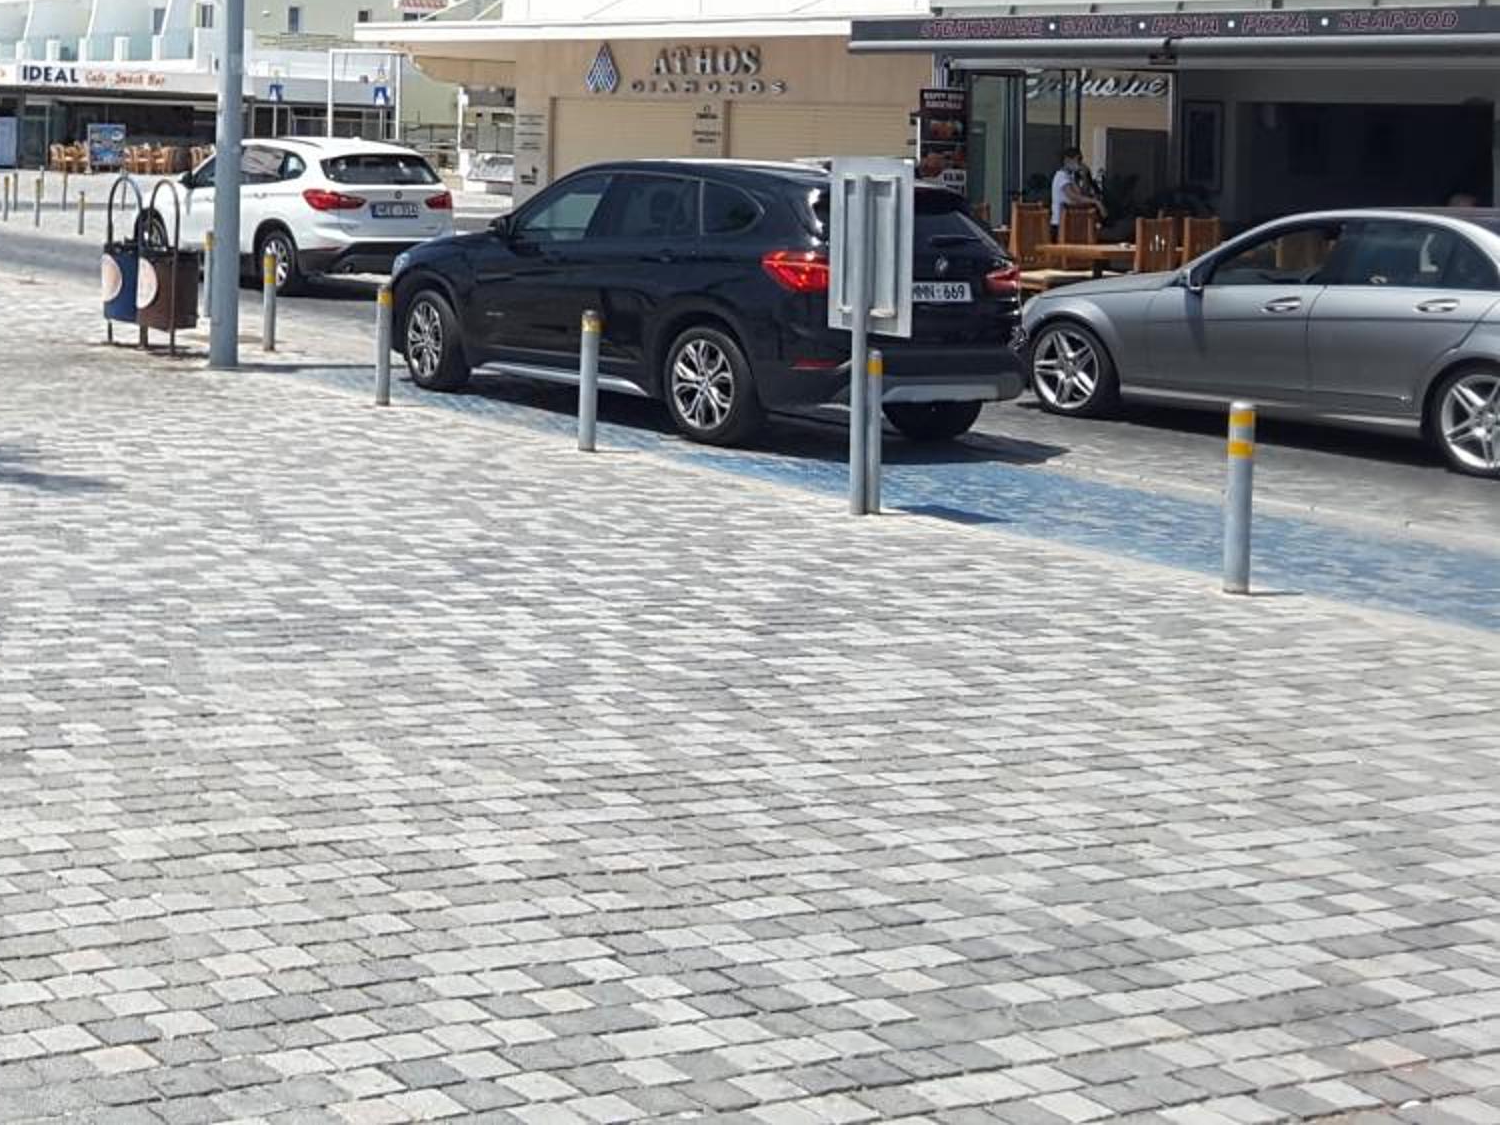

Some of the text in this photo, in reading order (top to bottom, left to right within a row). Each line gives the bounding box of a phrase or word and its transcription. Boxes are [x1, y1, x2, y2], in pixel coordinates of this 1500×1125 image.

[1338, 9, 1459, 31] SEAFOOD
[654, 45, 761, 75] ATHOS
[22, 65, 79, 84] IDEAL
[631, 79, 787, 94] DIAMONDS
